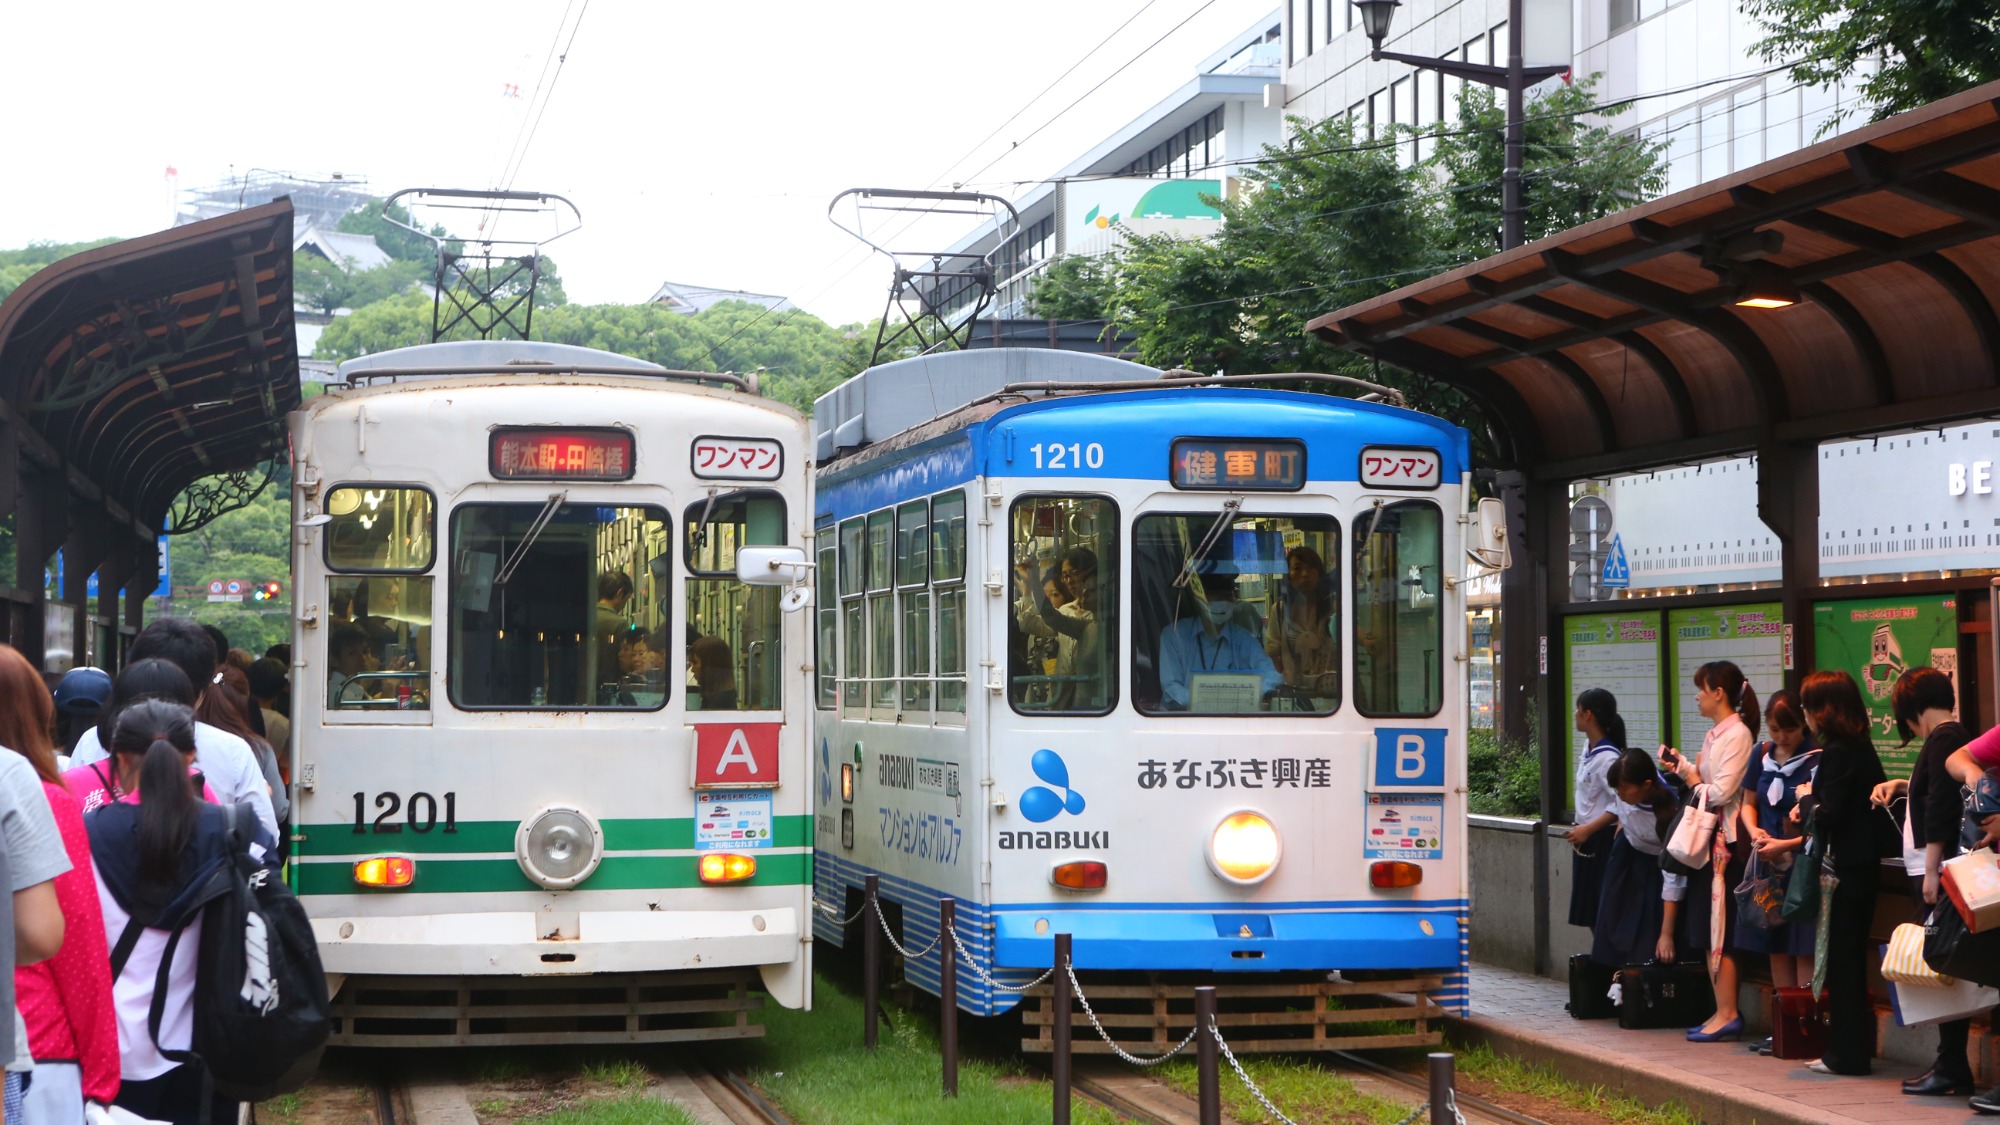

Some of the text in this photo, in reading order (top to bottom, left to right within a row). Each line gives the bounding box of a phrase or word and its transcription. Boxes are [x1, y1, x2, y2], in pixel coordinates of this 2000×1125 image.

[500, 440, 623, 475] 熊本駅・田崎橋
[697, 446, 777, 470] ワンマン
[1029, 443, 1105, 469] 1210
[1184, 450, 1298, 485] 健軍町
[1365, 457, 1434, 479] ワンマン
[716, 728, 758, 775] A
[1395, 734, 1426, 778] B
[1138, 758, 1331, 789] あなぶき興産
[352, 791, 458, 834] 1201
[879, 807, 962, 866] マンションはアルファ
